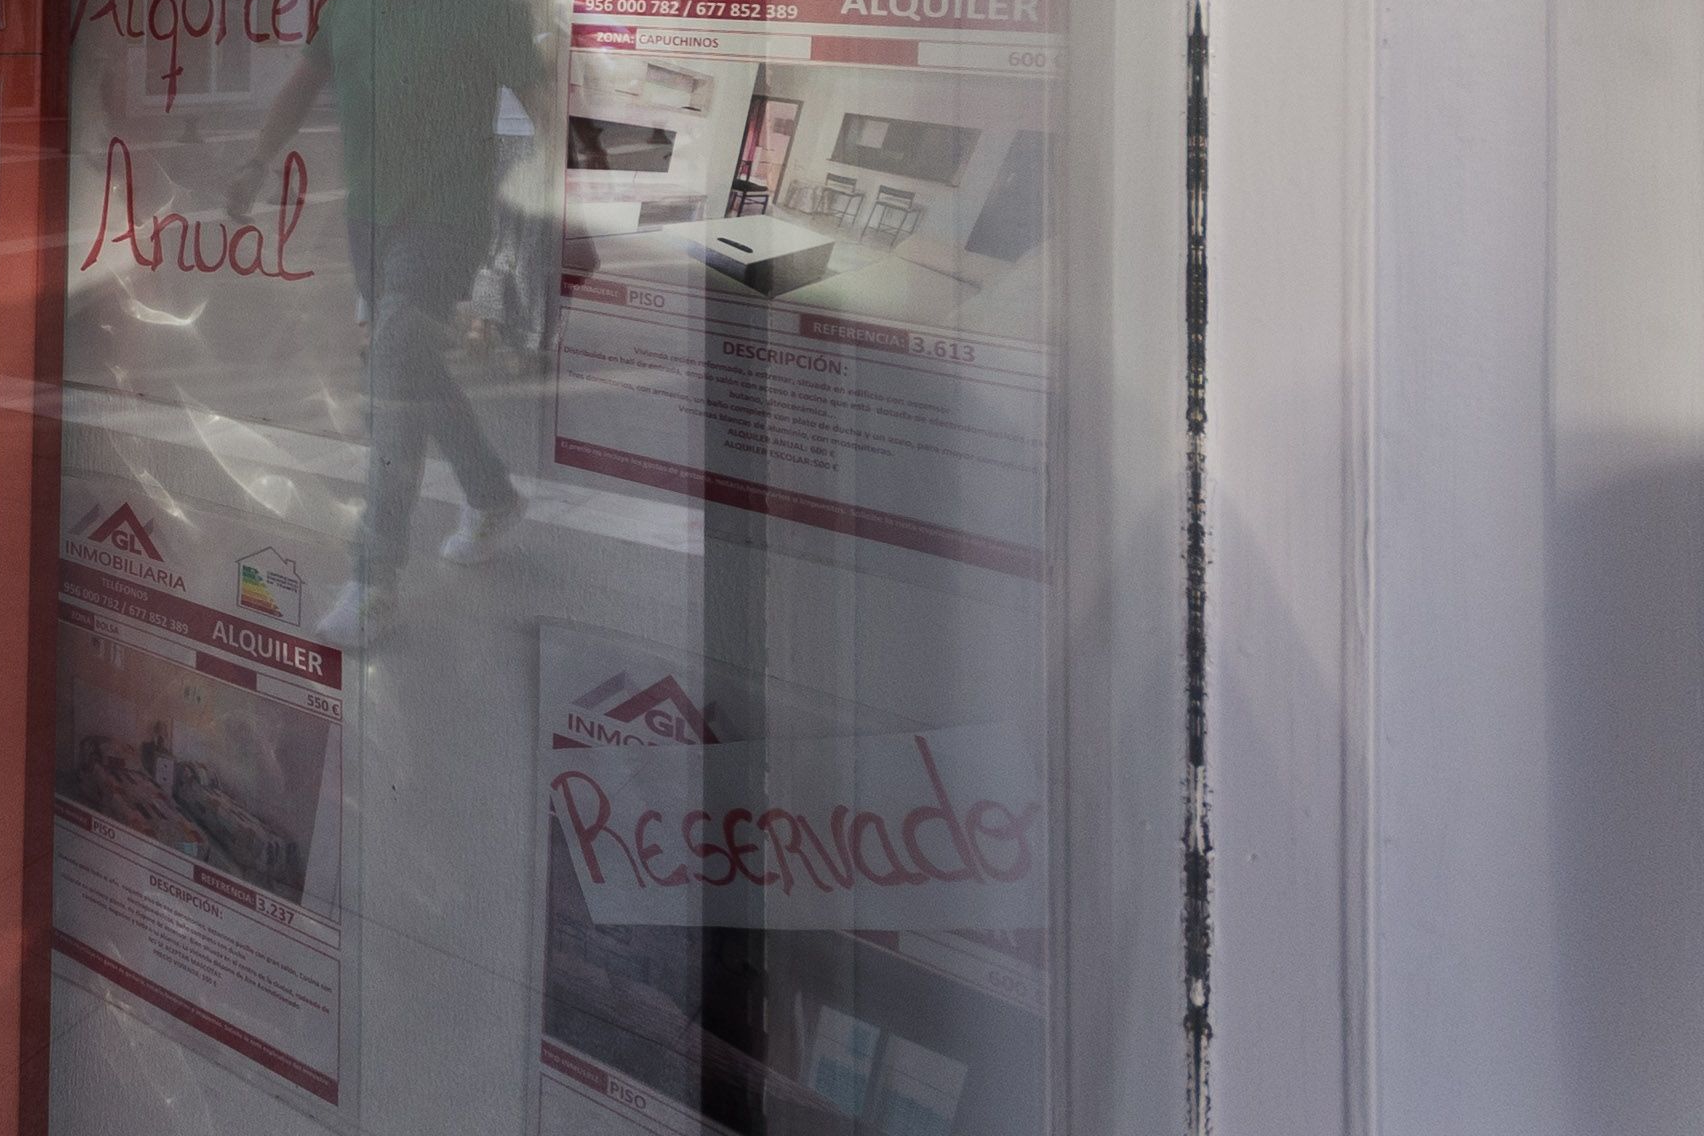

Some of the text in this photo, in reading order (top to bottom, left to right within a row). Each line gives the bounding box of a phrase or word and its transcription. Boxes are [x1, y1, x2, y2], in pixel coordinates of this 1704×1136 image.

[585, 0, 615, 13] 956
[616, 0, 647, 14] 000
[650, 0, 679, 15] 782
[695, 1, 725, 17] 677
[730, 2, 762, 18] 852
[766, 4, 798, 20] 389
[596, 32, 635, 45] ZONA:
[638, 33, 719, 50] CAPUCHINOS
[80, 137, 315, 282] Anual
[628, 289, 976, 363] PISO REFERENCIA: 3.613
[722, 340, 849, 377] DESCRIPCIÓN:
[111, 530, 143, 556] GL
[65, 540, 186, 592] INMOBILIARIA
[169, 620, 188, 635] 389
[212, 620, 323, 677] ALQUILER
[307, 694, 329, 712] 550
[93, 820, 116, 841] PISO
[149, 875, 223, 919] DESCRIPCIÓN:
[257, 893, 296, 925] 3.237
[608, 1075, 648, 1110] PISO
